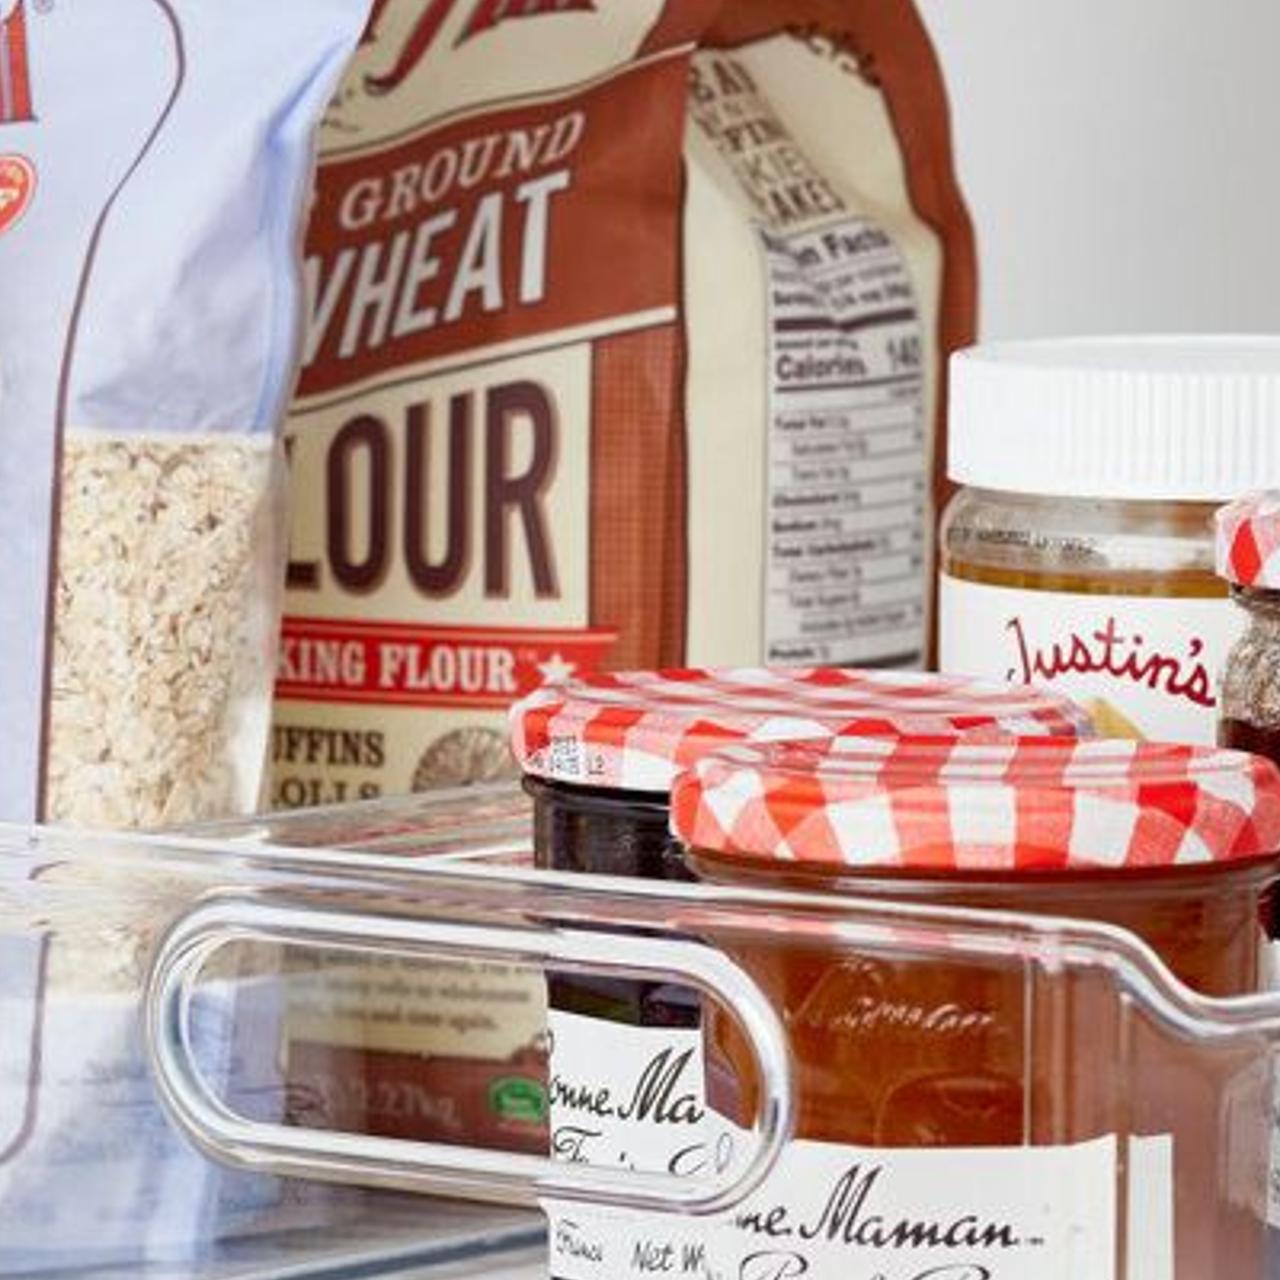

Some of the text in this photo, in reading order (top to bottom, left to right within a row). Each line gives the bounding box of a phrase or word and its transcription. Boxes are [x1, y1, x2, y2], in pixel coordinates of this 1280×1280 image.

[341, 111, 586, 229] GROUND
[775, 354, 867, 381] Calories
[285, 379, 562, 601] OUR
[276, 636, 517, 692] KING FLOUR
[1006, 616, 1217, 708] Justin's
[789, 1163, 1020, 1248] Maman
